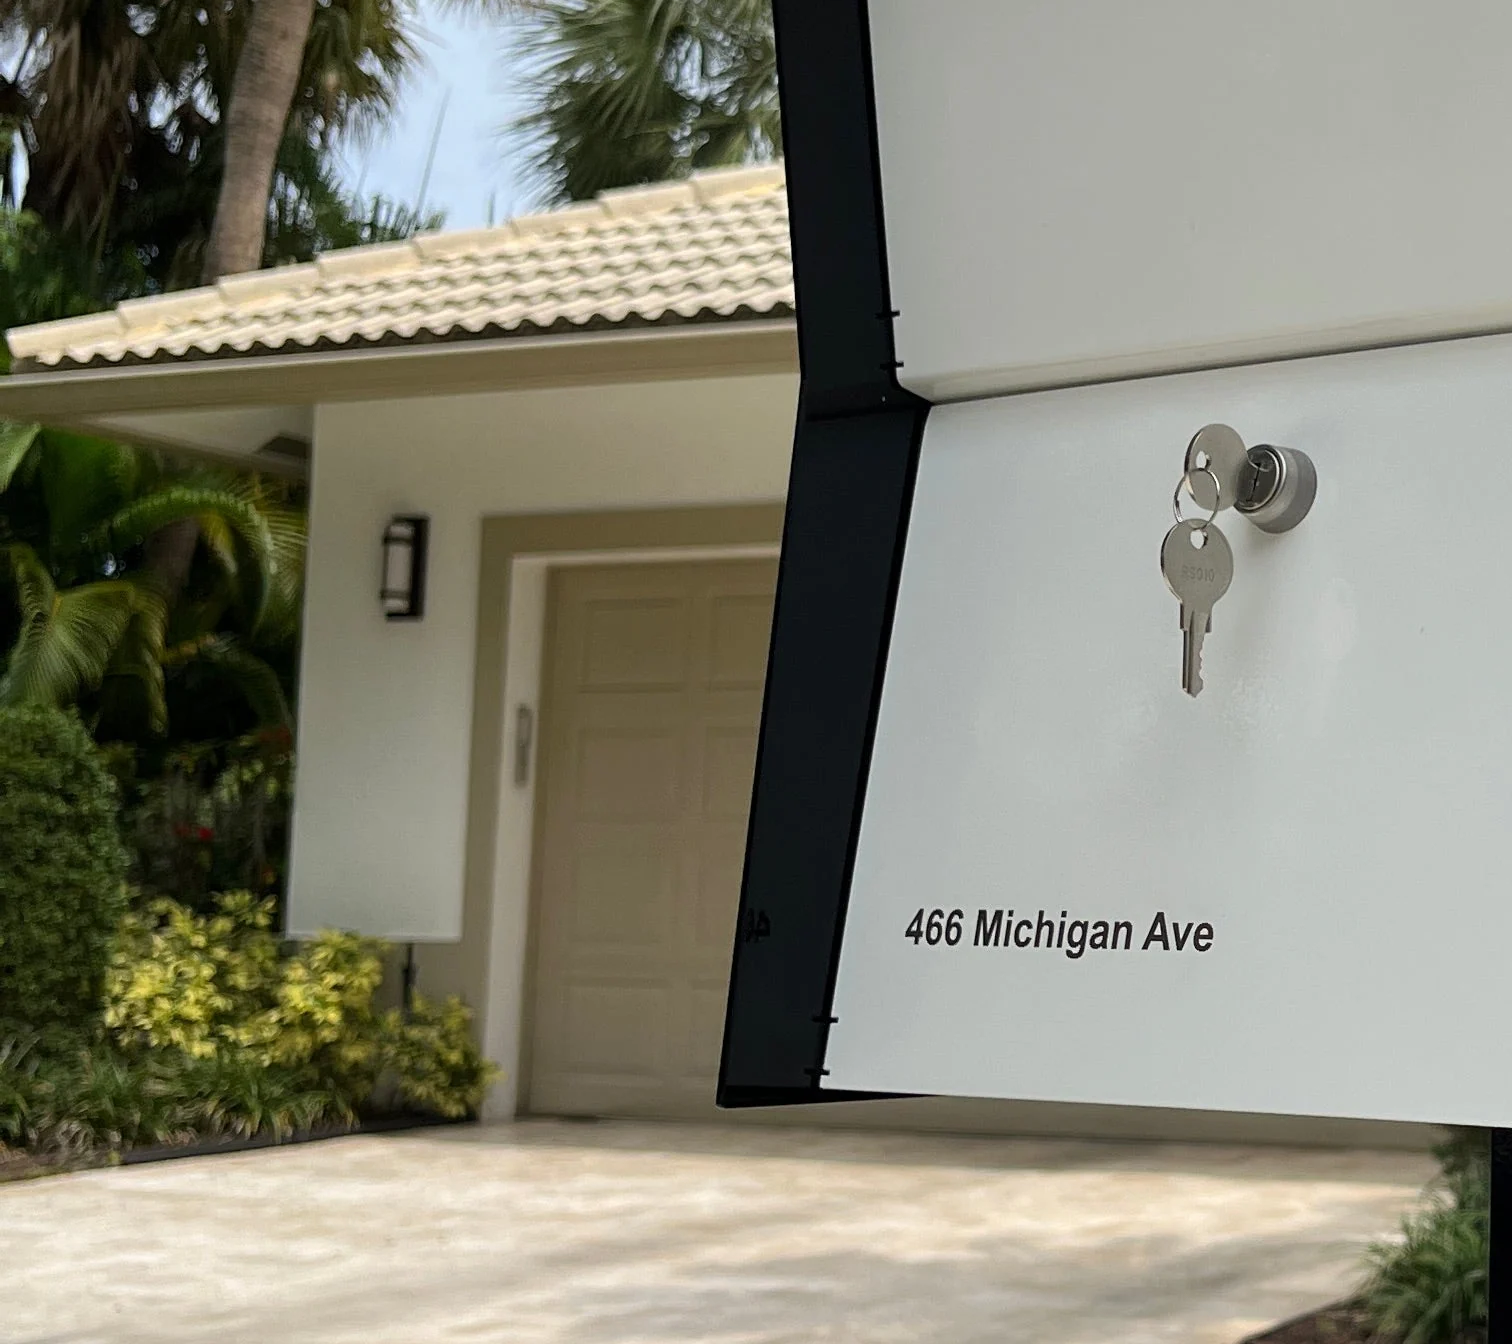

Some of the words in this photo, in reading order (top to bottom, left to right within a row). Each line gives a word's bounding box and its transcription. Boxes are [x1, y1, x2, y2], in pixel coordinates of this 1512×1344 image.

[905, 908, 963, 947] 466
[973, 909, 1133, 959] Michigan
[1141, 911, 1214, 952] Ave
